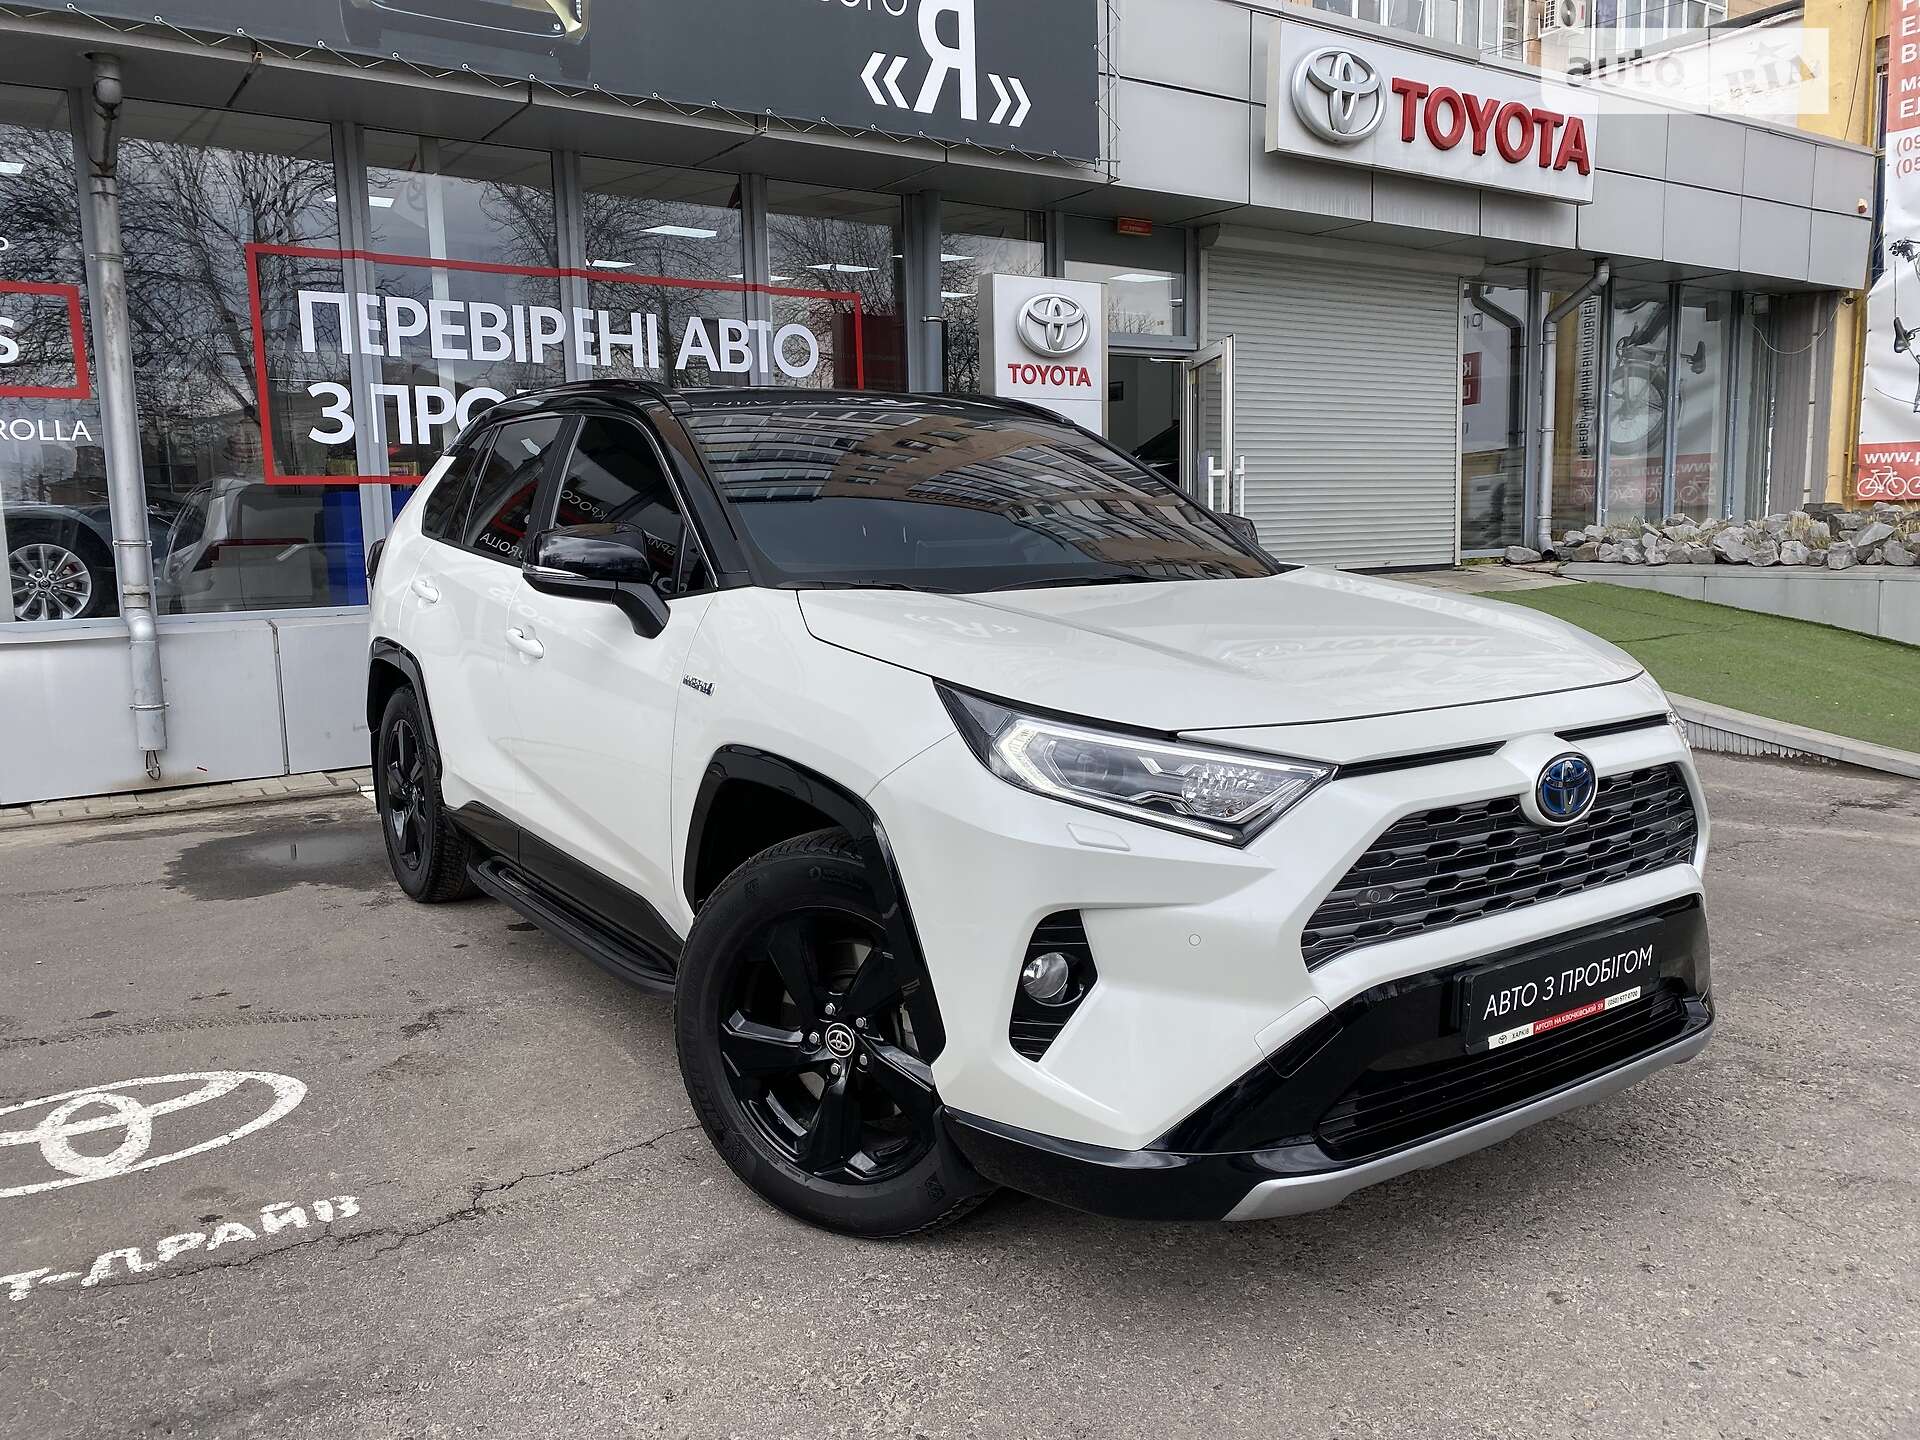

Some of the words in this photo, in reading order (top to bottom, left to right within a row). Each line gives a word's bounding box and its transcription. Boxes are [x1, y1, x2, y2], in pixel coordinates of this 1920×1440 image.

[1392, 77, 1590, 176] TOYOTA
[298, 290, 660, 370] ПЕРЕВІРЕНІ
[675, 316, 819, 378] АВТО
[307, 381, 355, 445] З
[370, 382, 532, 445] ПРО
[1007, 363, 1092, 387] TOYOTA
[1483, 982, 1538, 1021] АВТО
[1542, 976, 1555, 1001] З
[1559, 944, 1653, 996] ПРОБІГОМ
